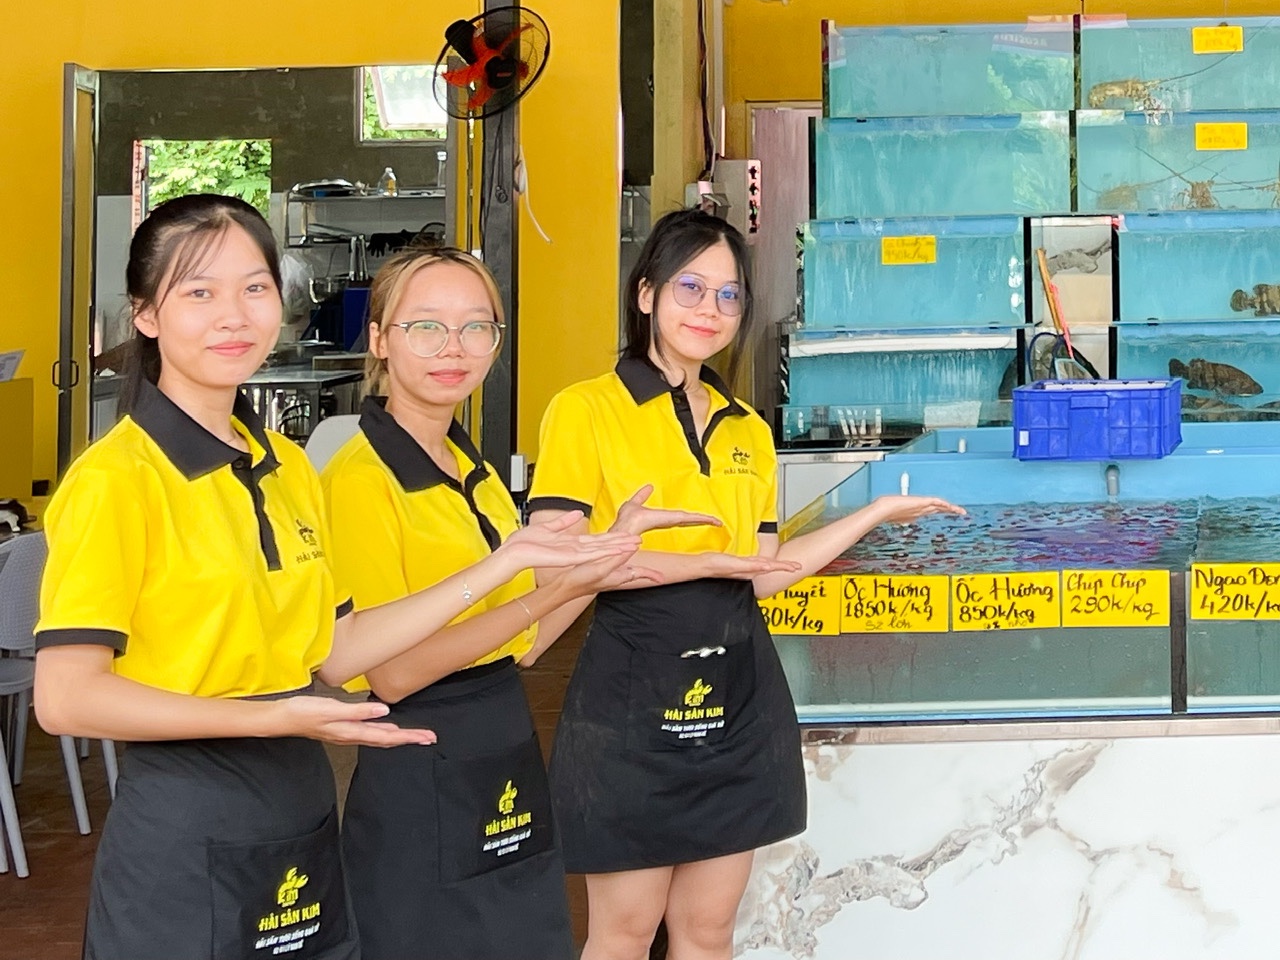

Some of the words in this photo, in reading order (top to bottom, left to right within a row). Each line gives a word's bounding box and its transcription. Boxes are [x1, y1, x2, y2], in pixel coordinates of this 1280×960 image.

[1195, 567, 1246, 595] Ngao
[959, 601, 1036, 623] 850k/kg
[1070, 594, 1160, 621] 290k/kg
[664, 708, 683, 720] HẢI
[684, 707, 704, 720] SẢN
[706, 706, 724, 718] KIM
[259, 912, 279, 932] HẢI
[280, 908, 300, 927] SẢN
[302, 902, 320, 921] KIM
